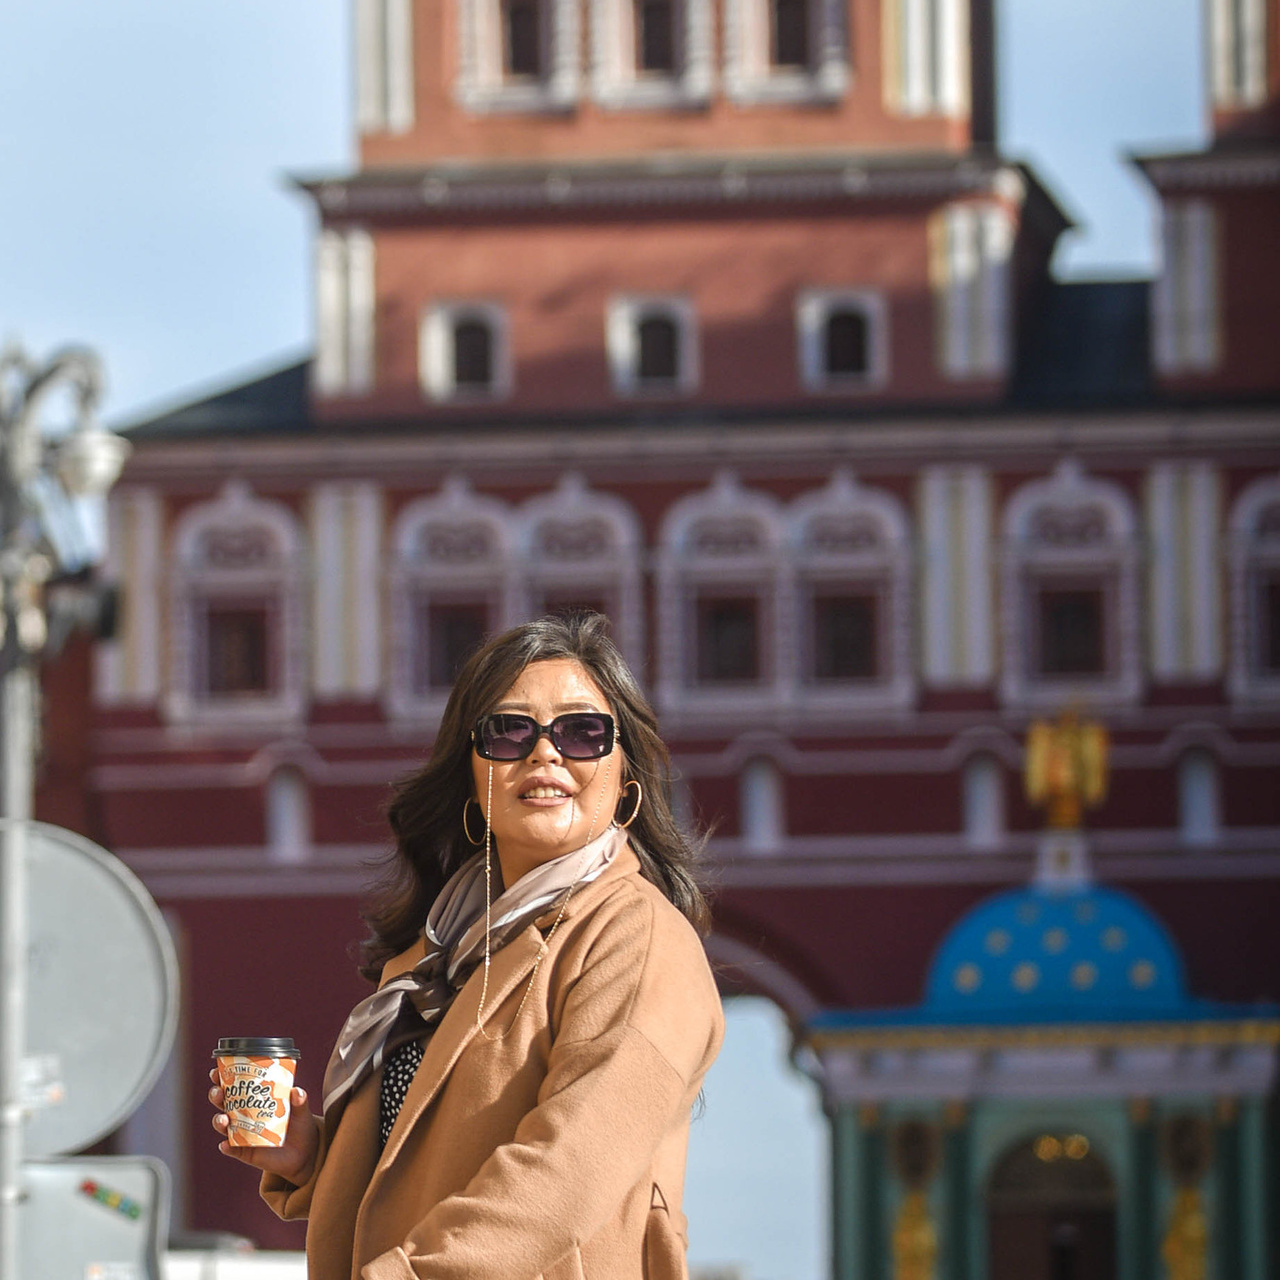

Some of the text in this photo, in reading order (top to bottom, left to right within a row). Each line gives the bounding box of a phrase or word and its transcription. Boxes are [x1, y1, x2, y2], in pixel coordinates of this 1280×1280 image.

[234, 1065, 250, 1074] TIME
[254, 1067, 268, 1078] FOR
[225, 1080, 270, 1098] coffee
[256, 1109, 274, 1119] tea
